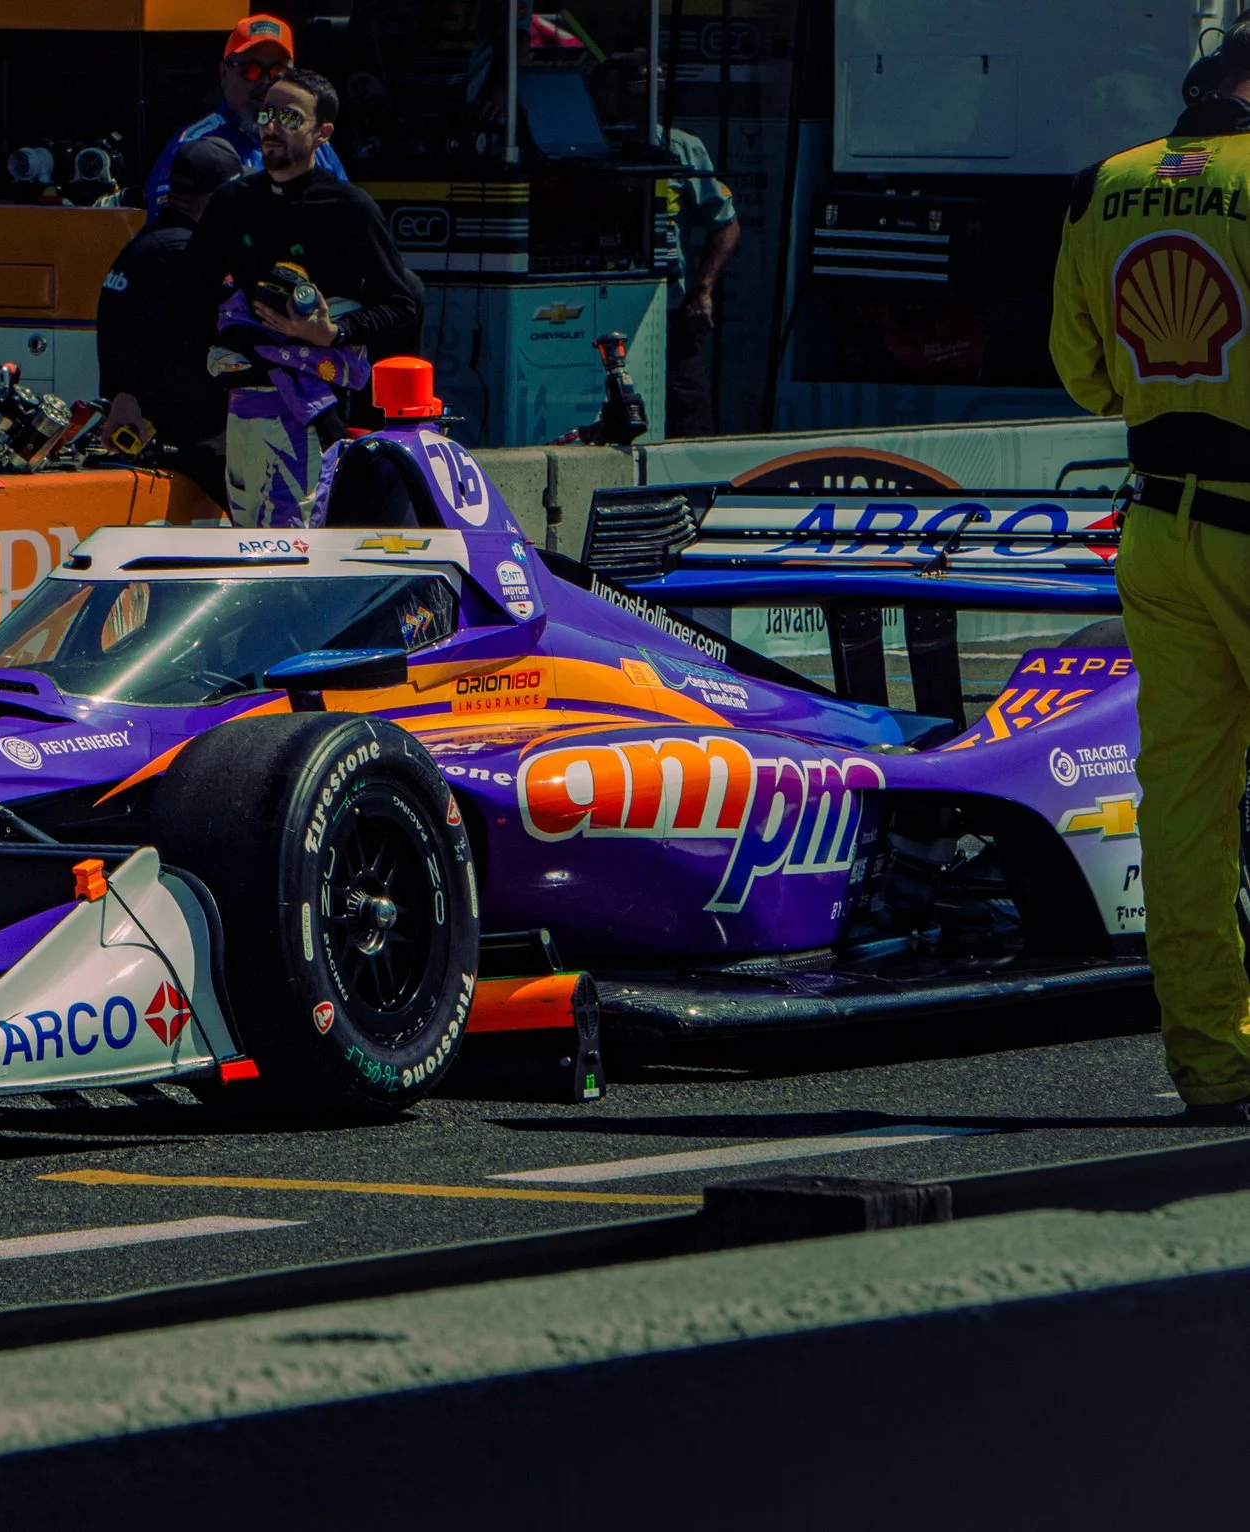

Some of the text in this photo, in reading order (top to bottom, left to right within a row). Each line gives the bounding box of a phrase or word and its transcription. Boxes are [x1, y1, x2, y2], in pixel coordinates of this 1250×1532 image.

[1102, 185, 1248, 221] OFFICIAL
[398, 215, 441, 238] ecr
[530, 331, 586, 341] CHEVROLET
[765, 503, 1069, 556] ARCO
[238, 540, 291, 554] ARCO
[502, 586, 530, 596] INDYCAR
[590, 573, 727, 664] JuncosHollinger.com
[456, 671, 541, 695] ORION180
[458, 694, 540, 711] INSURANCE
[1076, 745, 1128, 762] TRACKER
[304, 740, 380, 855] Firestone
[516, 734, 887, 914] ampm
[323, 932, 349, 1001] RACING
[402, 974, 476, 1089] Firestone
